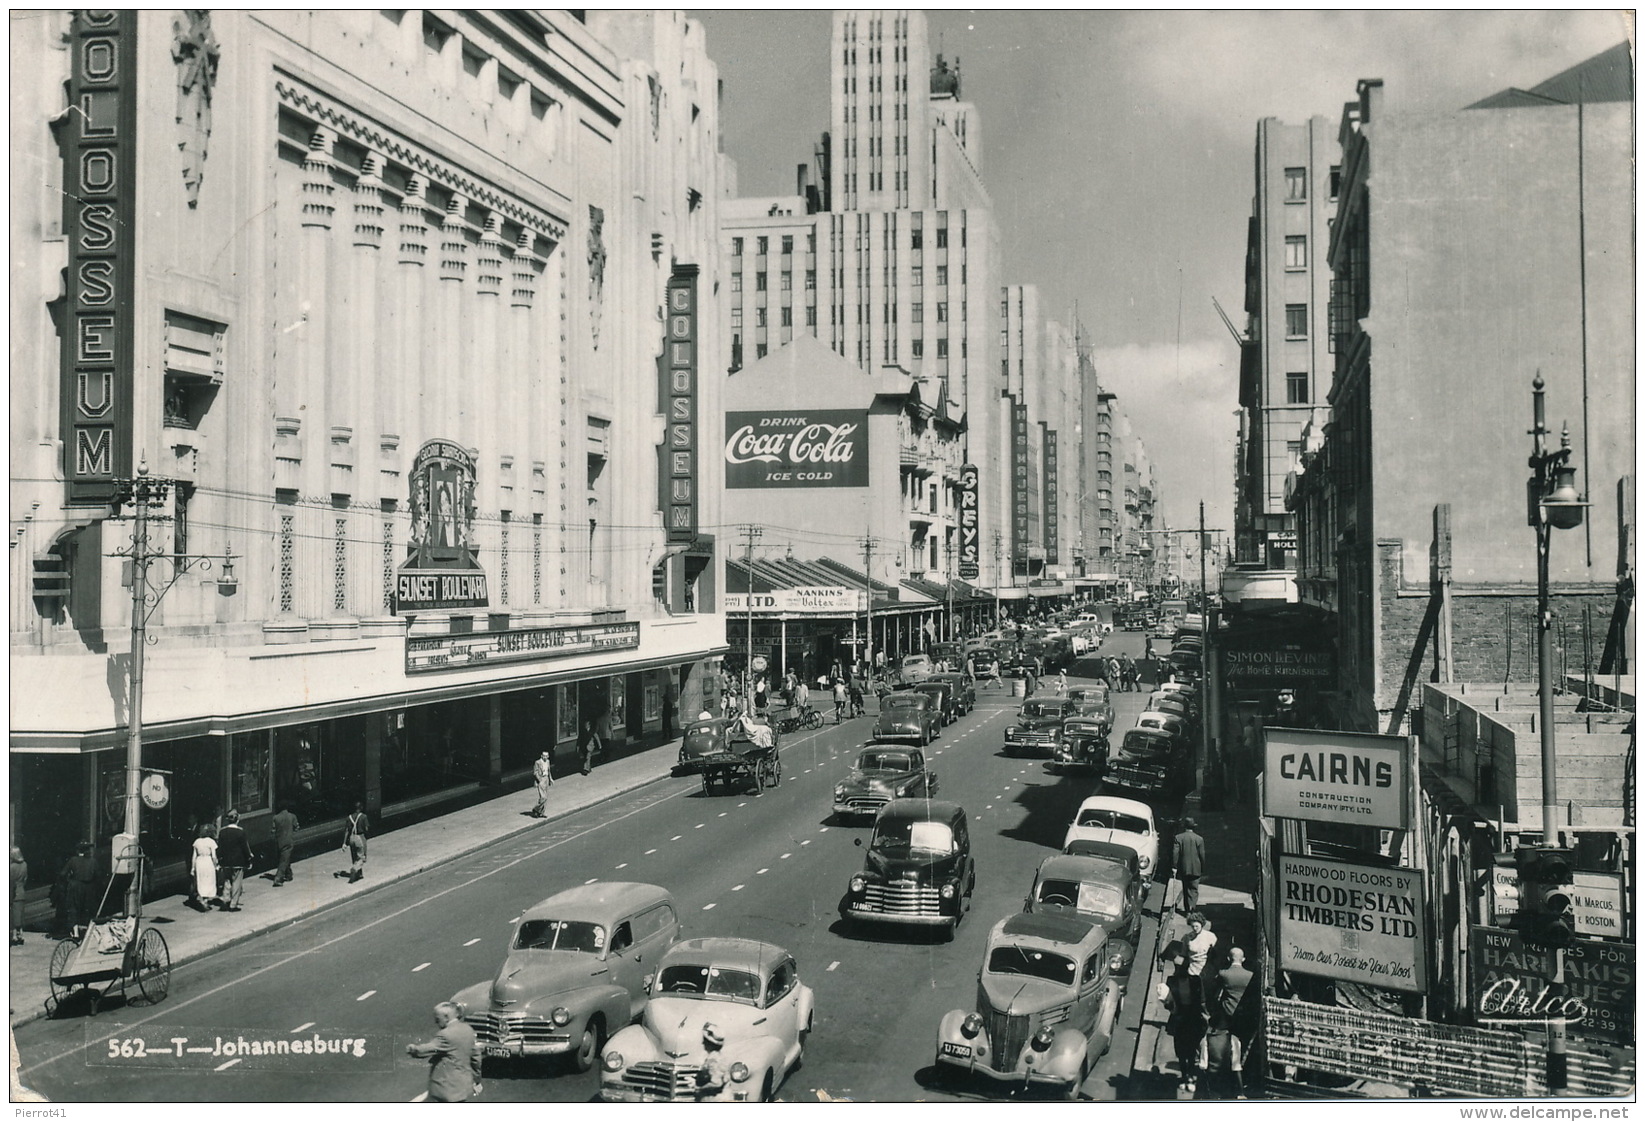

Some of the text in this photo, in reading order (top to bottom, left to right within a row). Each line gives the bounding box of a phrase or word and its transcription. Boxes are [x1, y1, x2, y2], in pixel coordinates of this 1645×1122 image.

[673, 288, 690, 528] COLOSSEUM
[760, 417, 807, 427] DRINK
[1016, 410, 1026, 445] HIS
[725, 423, 858, 464] Coca-Cola
[765, 472, 833, 481] ICE COLD
[400, 576, 487, 601] SUNSET BOULEVARD
[796, 589, 843, 597] NANKINS
[746, 597, 777, 607] LTD.
[497, 633, 525, 653] SUNSET
[1226, 650, 1272, 663] SIMON
[1280, 753, 1392, 788] CAIRNS
[152, 784, 162, 792] NO
[1299, 791, 1372, 804] CONSTRUCTION
[1299, 801, 1338, 811] COMPANY
[1357, 806, 1373, 815] LTD.
[1285, 863, 1411, 890] HARDWOOD FLOORS BY
[1286, 880, 1415, 917] RHODESIAN
[1285, 902, 1418, 940] TIMBERS LTD.
[1486, 935, 1511, 947] NEW
[1600, 949, 1627, 963] FOR
